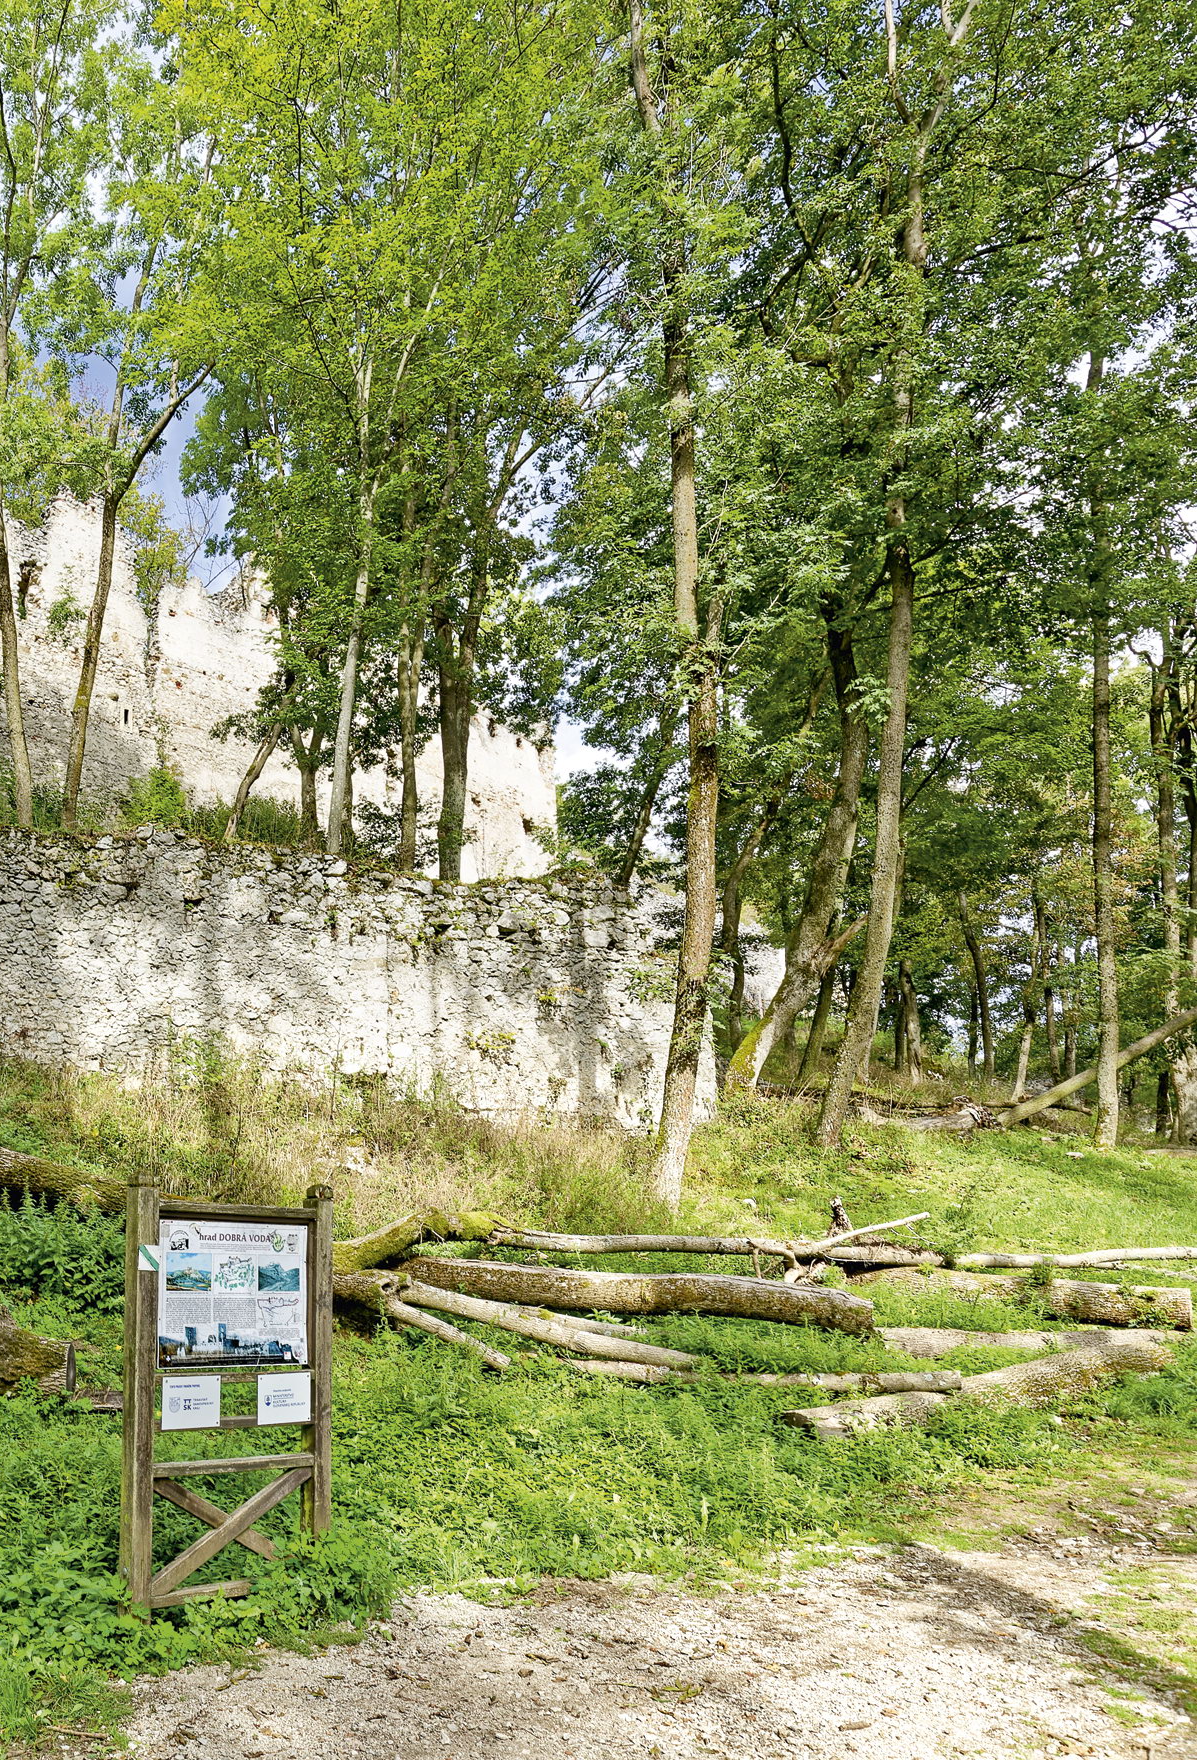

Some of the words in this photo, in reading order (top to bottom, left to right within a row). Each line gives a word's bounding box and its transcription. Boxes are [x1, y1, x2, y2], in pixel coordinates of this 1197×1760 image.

[199, 1233, 217, 1241] hrad
[219, 1232, 247, 1242] DOBRÁ
[249, 1234, 271, 1242] VODA
